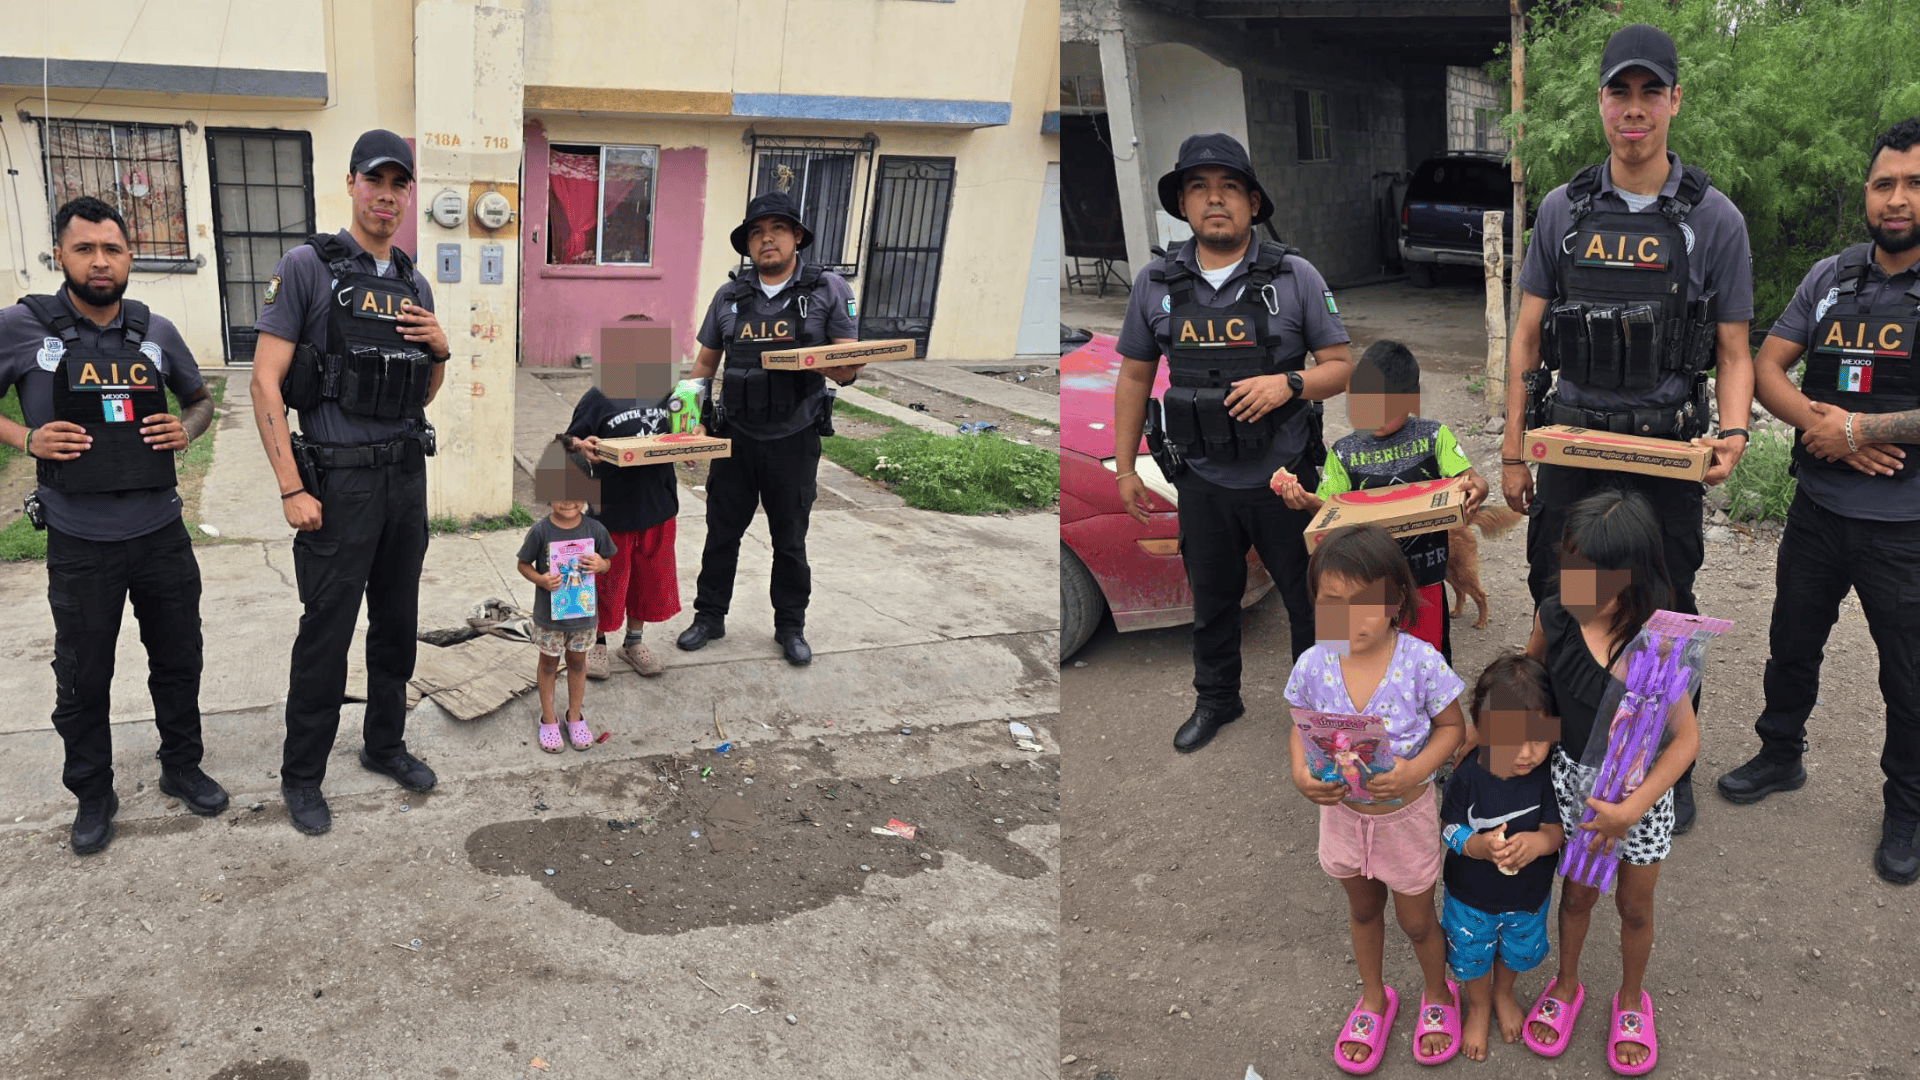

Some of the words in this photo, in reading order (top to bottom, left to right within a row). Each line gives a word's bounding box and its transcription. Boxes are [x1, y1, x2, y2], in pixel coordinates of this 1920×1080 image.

[425, 132, 462, 147] 718A
[484, 136, 509, 149] 718
[1584, 234, 1660, 262] A.I.C
[740, 320, 789, 339] A.I.C
[1180, 318, 1246, 342] A.I.C
[1824, 321, 1903, 350] A.I.C
[1841, 358, 1872, 366] MEXICO
[79, 362, 148, 385] A.I.C
[607, 409, 641, 429] YOUTH
[645, 408, 669, 419] CAM
[1349, 437, 1430, 467] AMERICAN
[1410, 547, 1447, 568] TER
